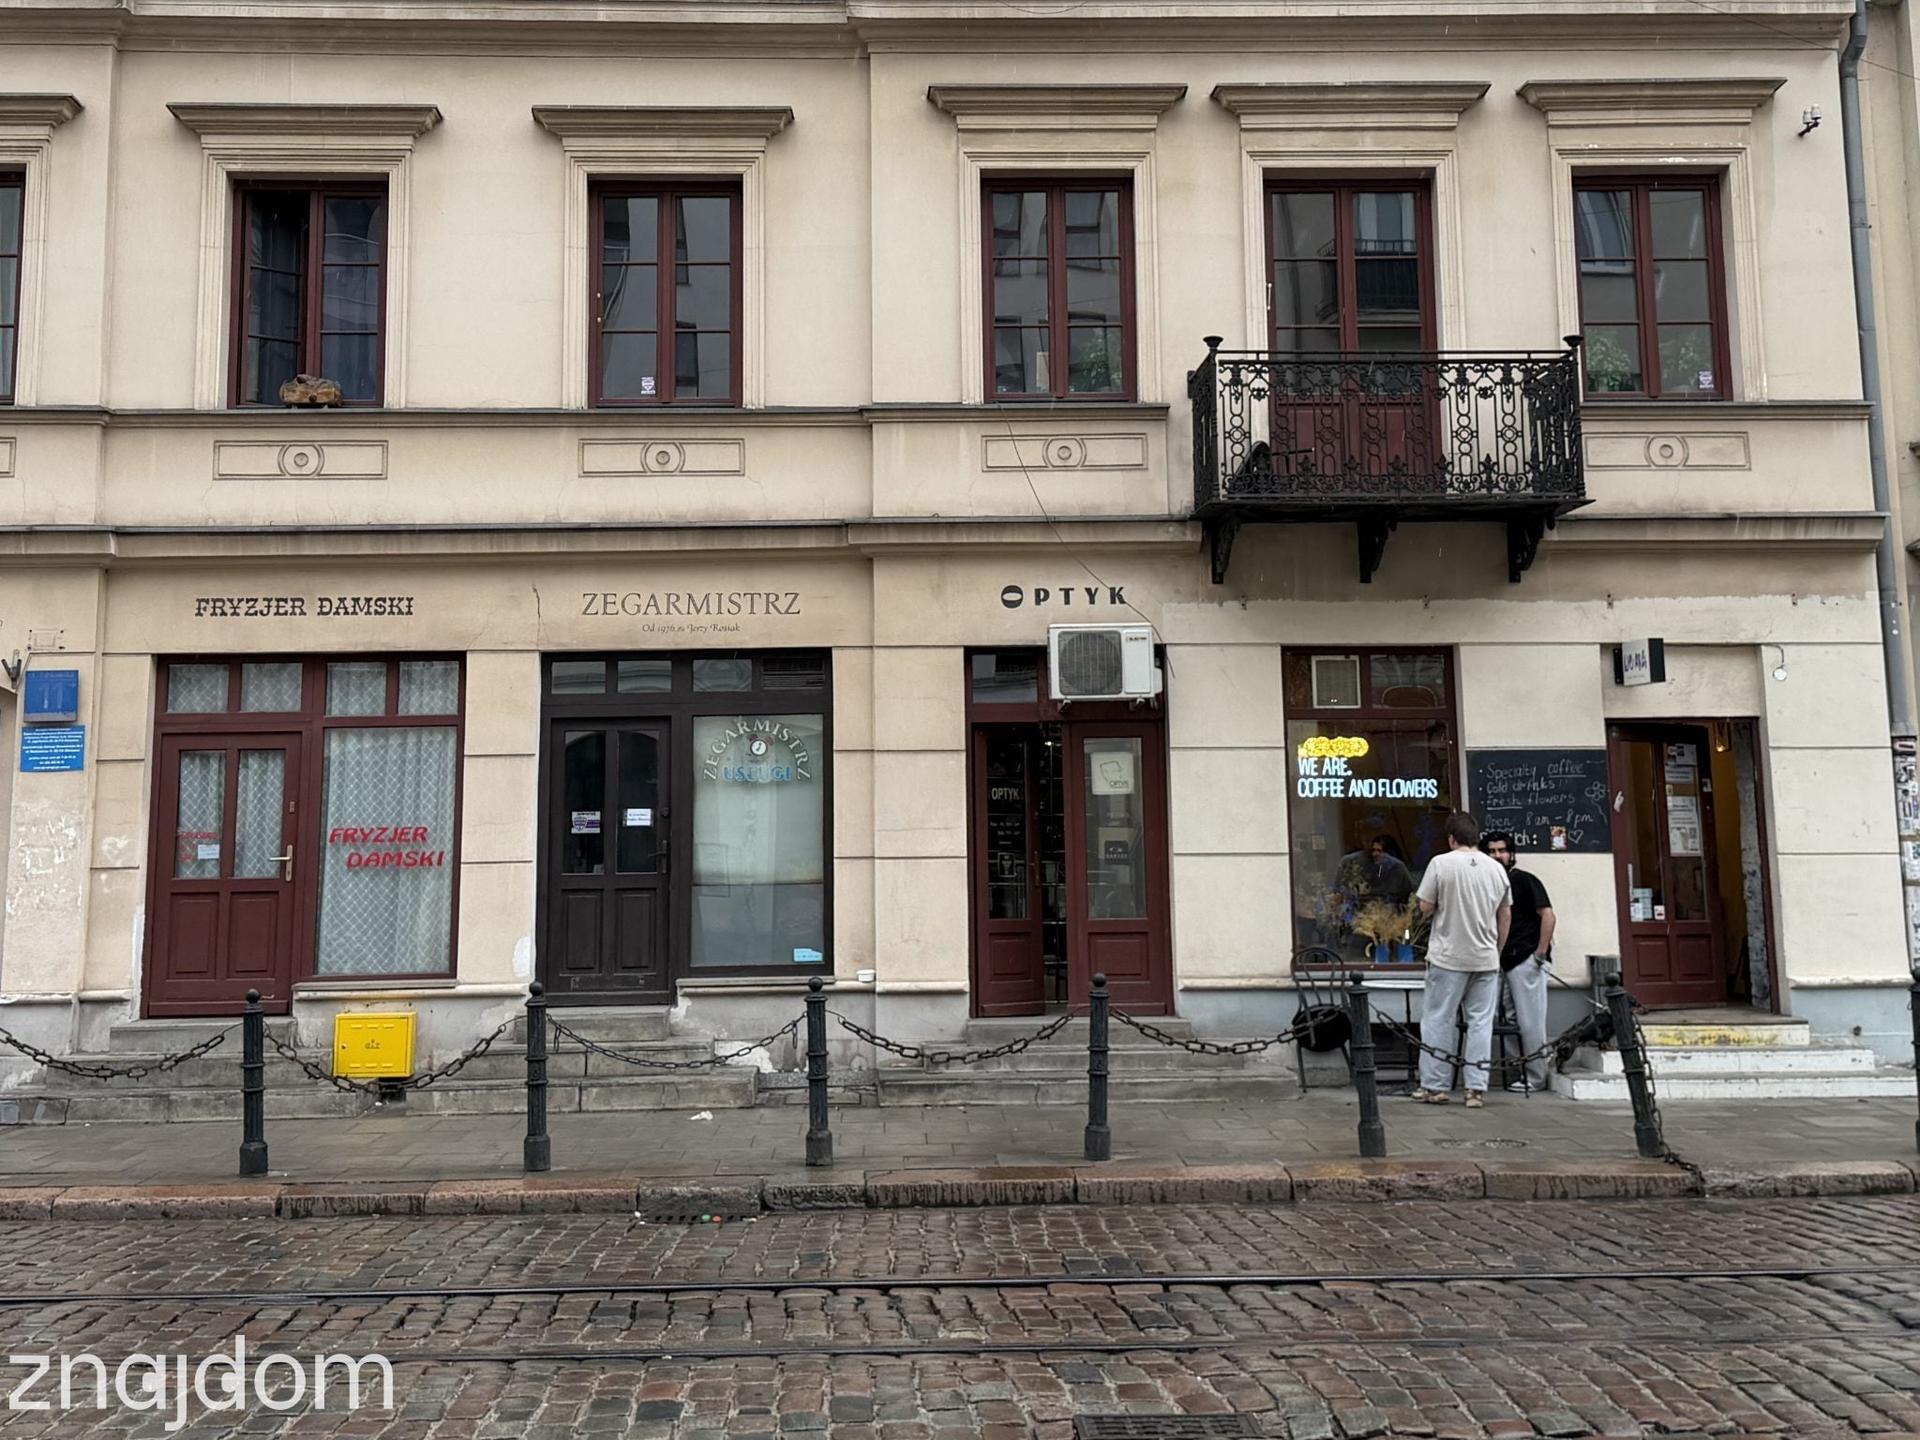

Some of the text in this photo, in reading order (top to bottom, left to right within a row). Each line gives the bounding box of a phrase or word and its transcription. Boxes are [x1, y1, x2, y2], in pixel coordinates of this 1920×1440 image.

[195, 596, 414, 616] FRYZJER DAMSKI
[582, 592, 801, 616] ZEGARMISTRZ
[1001, 585, 1126, 608] OPTYK
[703, 719, 811, 781] ZEGARMISTRZ
[1298, 757, 1353, 776] WE ARE.
[992, 787, 1019, 800] OPTYK
[1297, 778, 1438, 798] COFFEE AND FLOWERS
[329, 826, 428, 844] FRYZJER
[347, 851, 445, 869] DAMSKI
